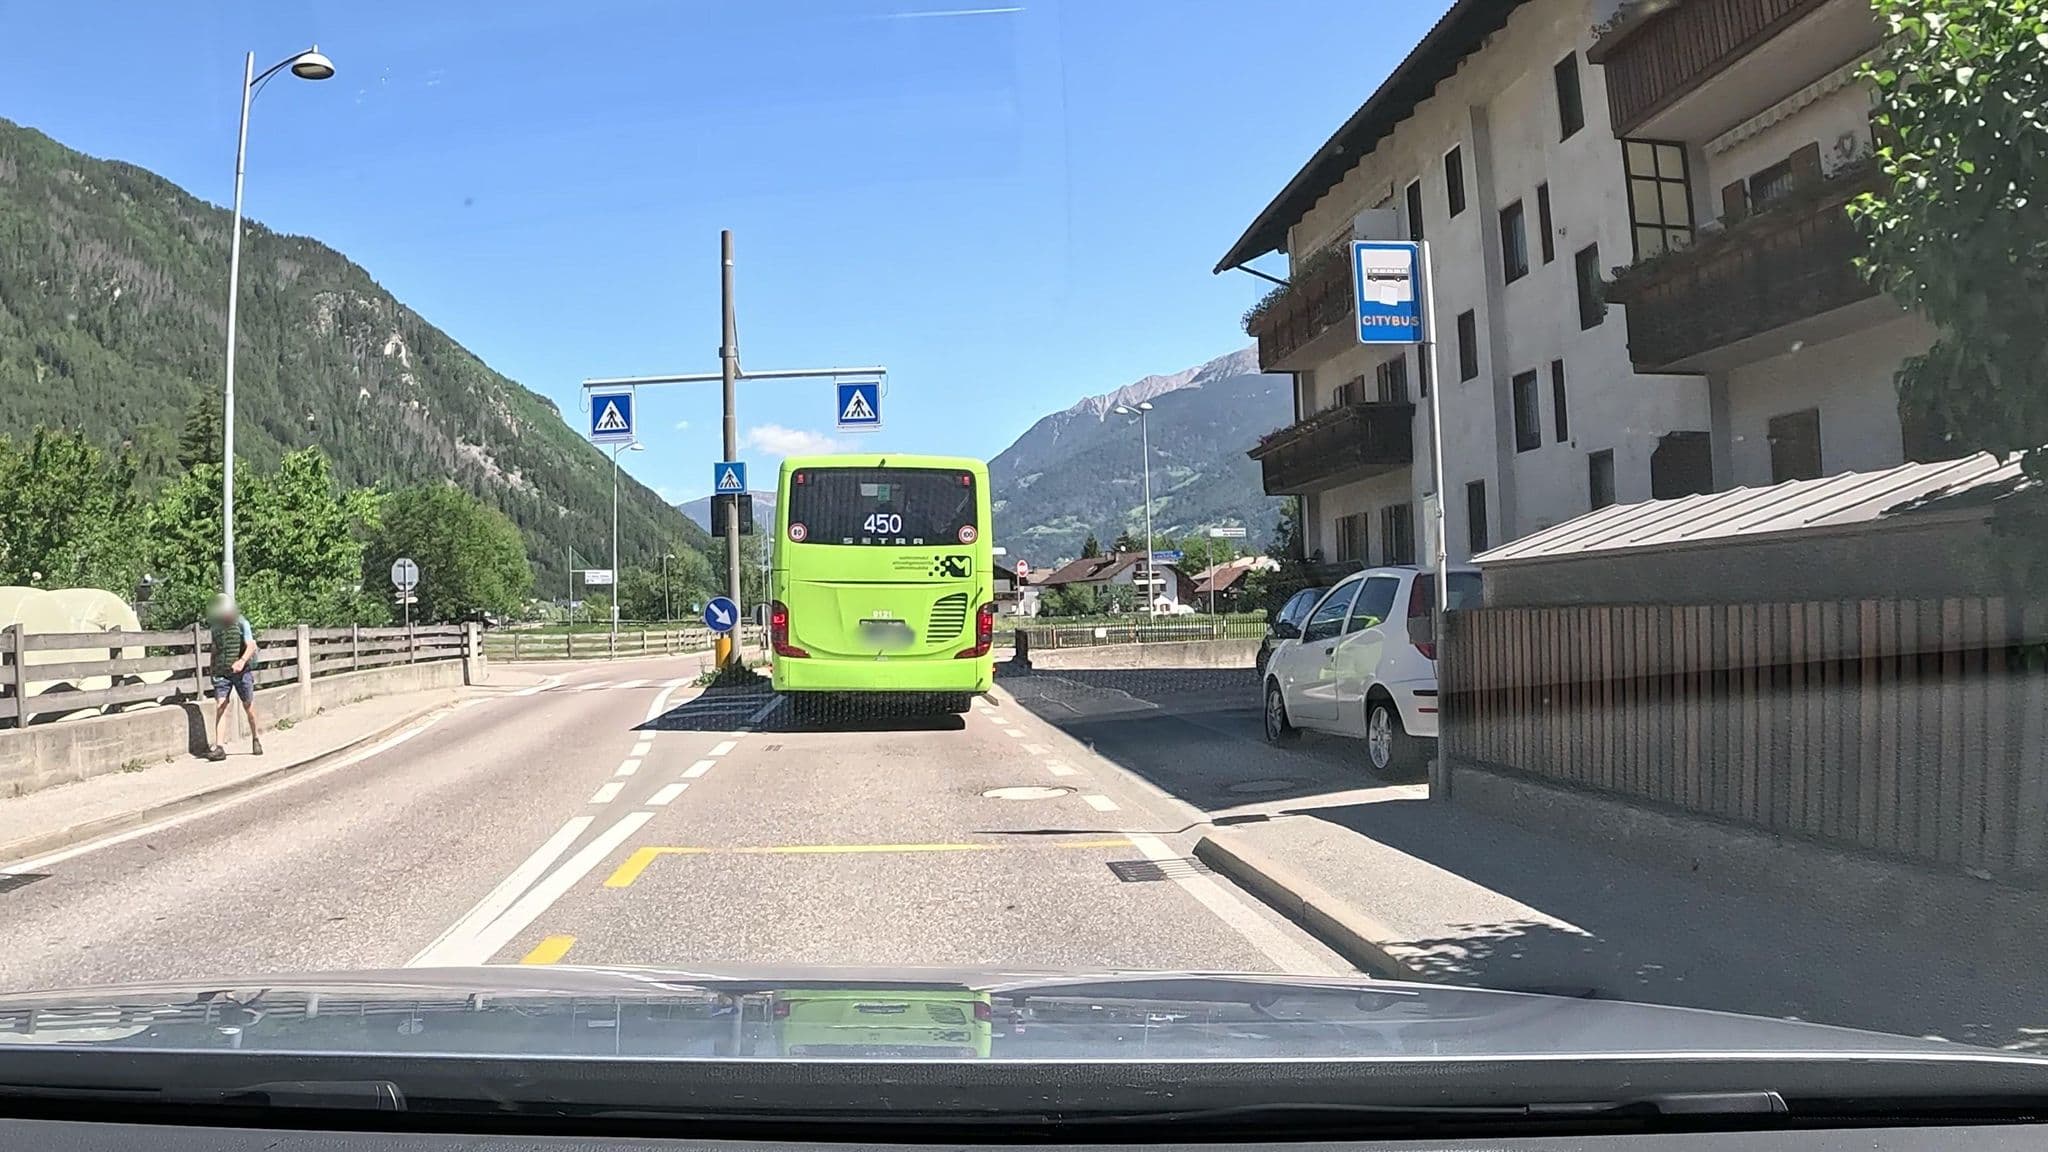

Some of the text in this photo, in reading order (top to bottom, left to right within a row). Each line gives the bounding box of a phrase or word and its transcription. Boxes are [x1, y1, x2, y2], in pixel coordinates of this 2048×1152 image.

[1362, 315, 1420, 326] CITYBUS
[864, 513, 902, 534] 450
[843, 537, 924, 545] SETRA
